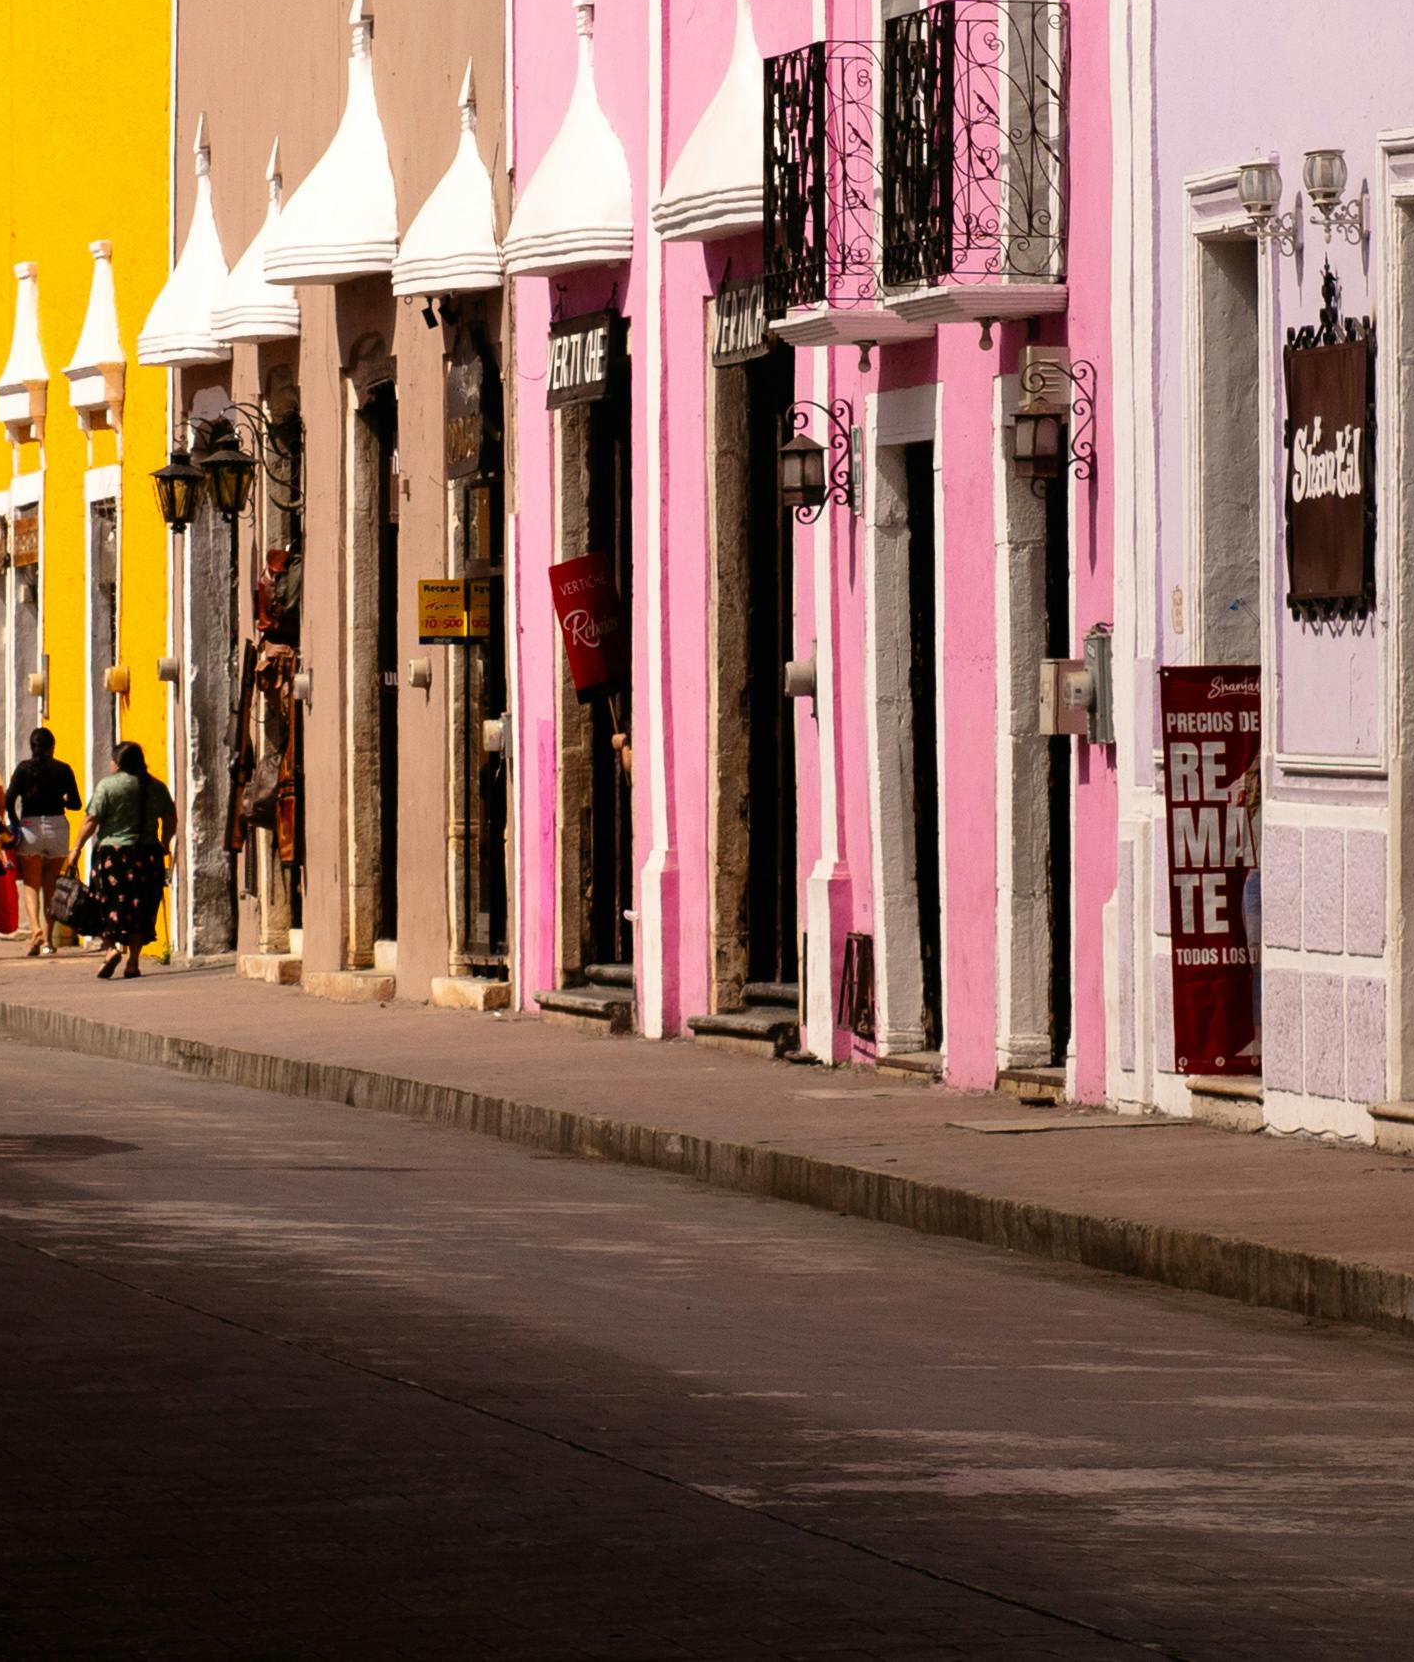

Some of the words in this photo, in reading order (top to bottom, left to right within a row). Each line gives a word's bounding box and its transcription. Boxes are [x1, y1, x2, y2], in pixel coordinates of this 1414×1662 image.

[713, 284, 765, 355] VERTICH
[548, 327, 607, 390] VERTICHE
[1292, 416, 1361, 503] Shantal
[1166, 711, 1234, 733] PRECIOS
[1238, 711, 1260, 732] DE
[1169, 741, 1229, 802] RE
[1172, 806, 1256, 868] MA
[1173, 873, 1230, 934] TE
[1176, 947, 1219, 966] TODOS
[1222, 947, 1247, 965] LOS
